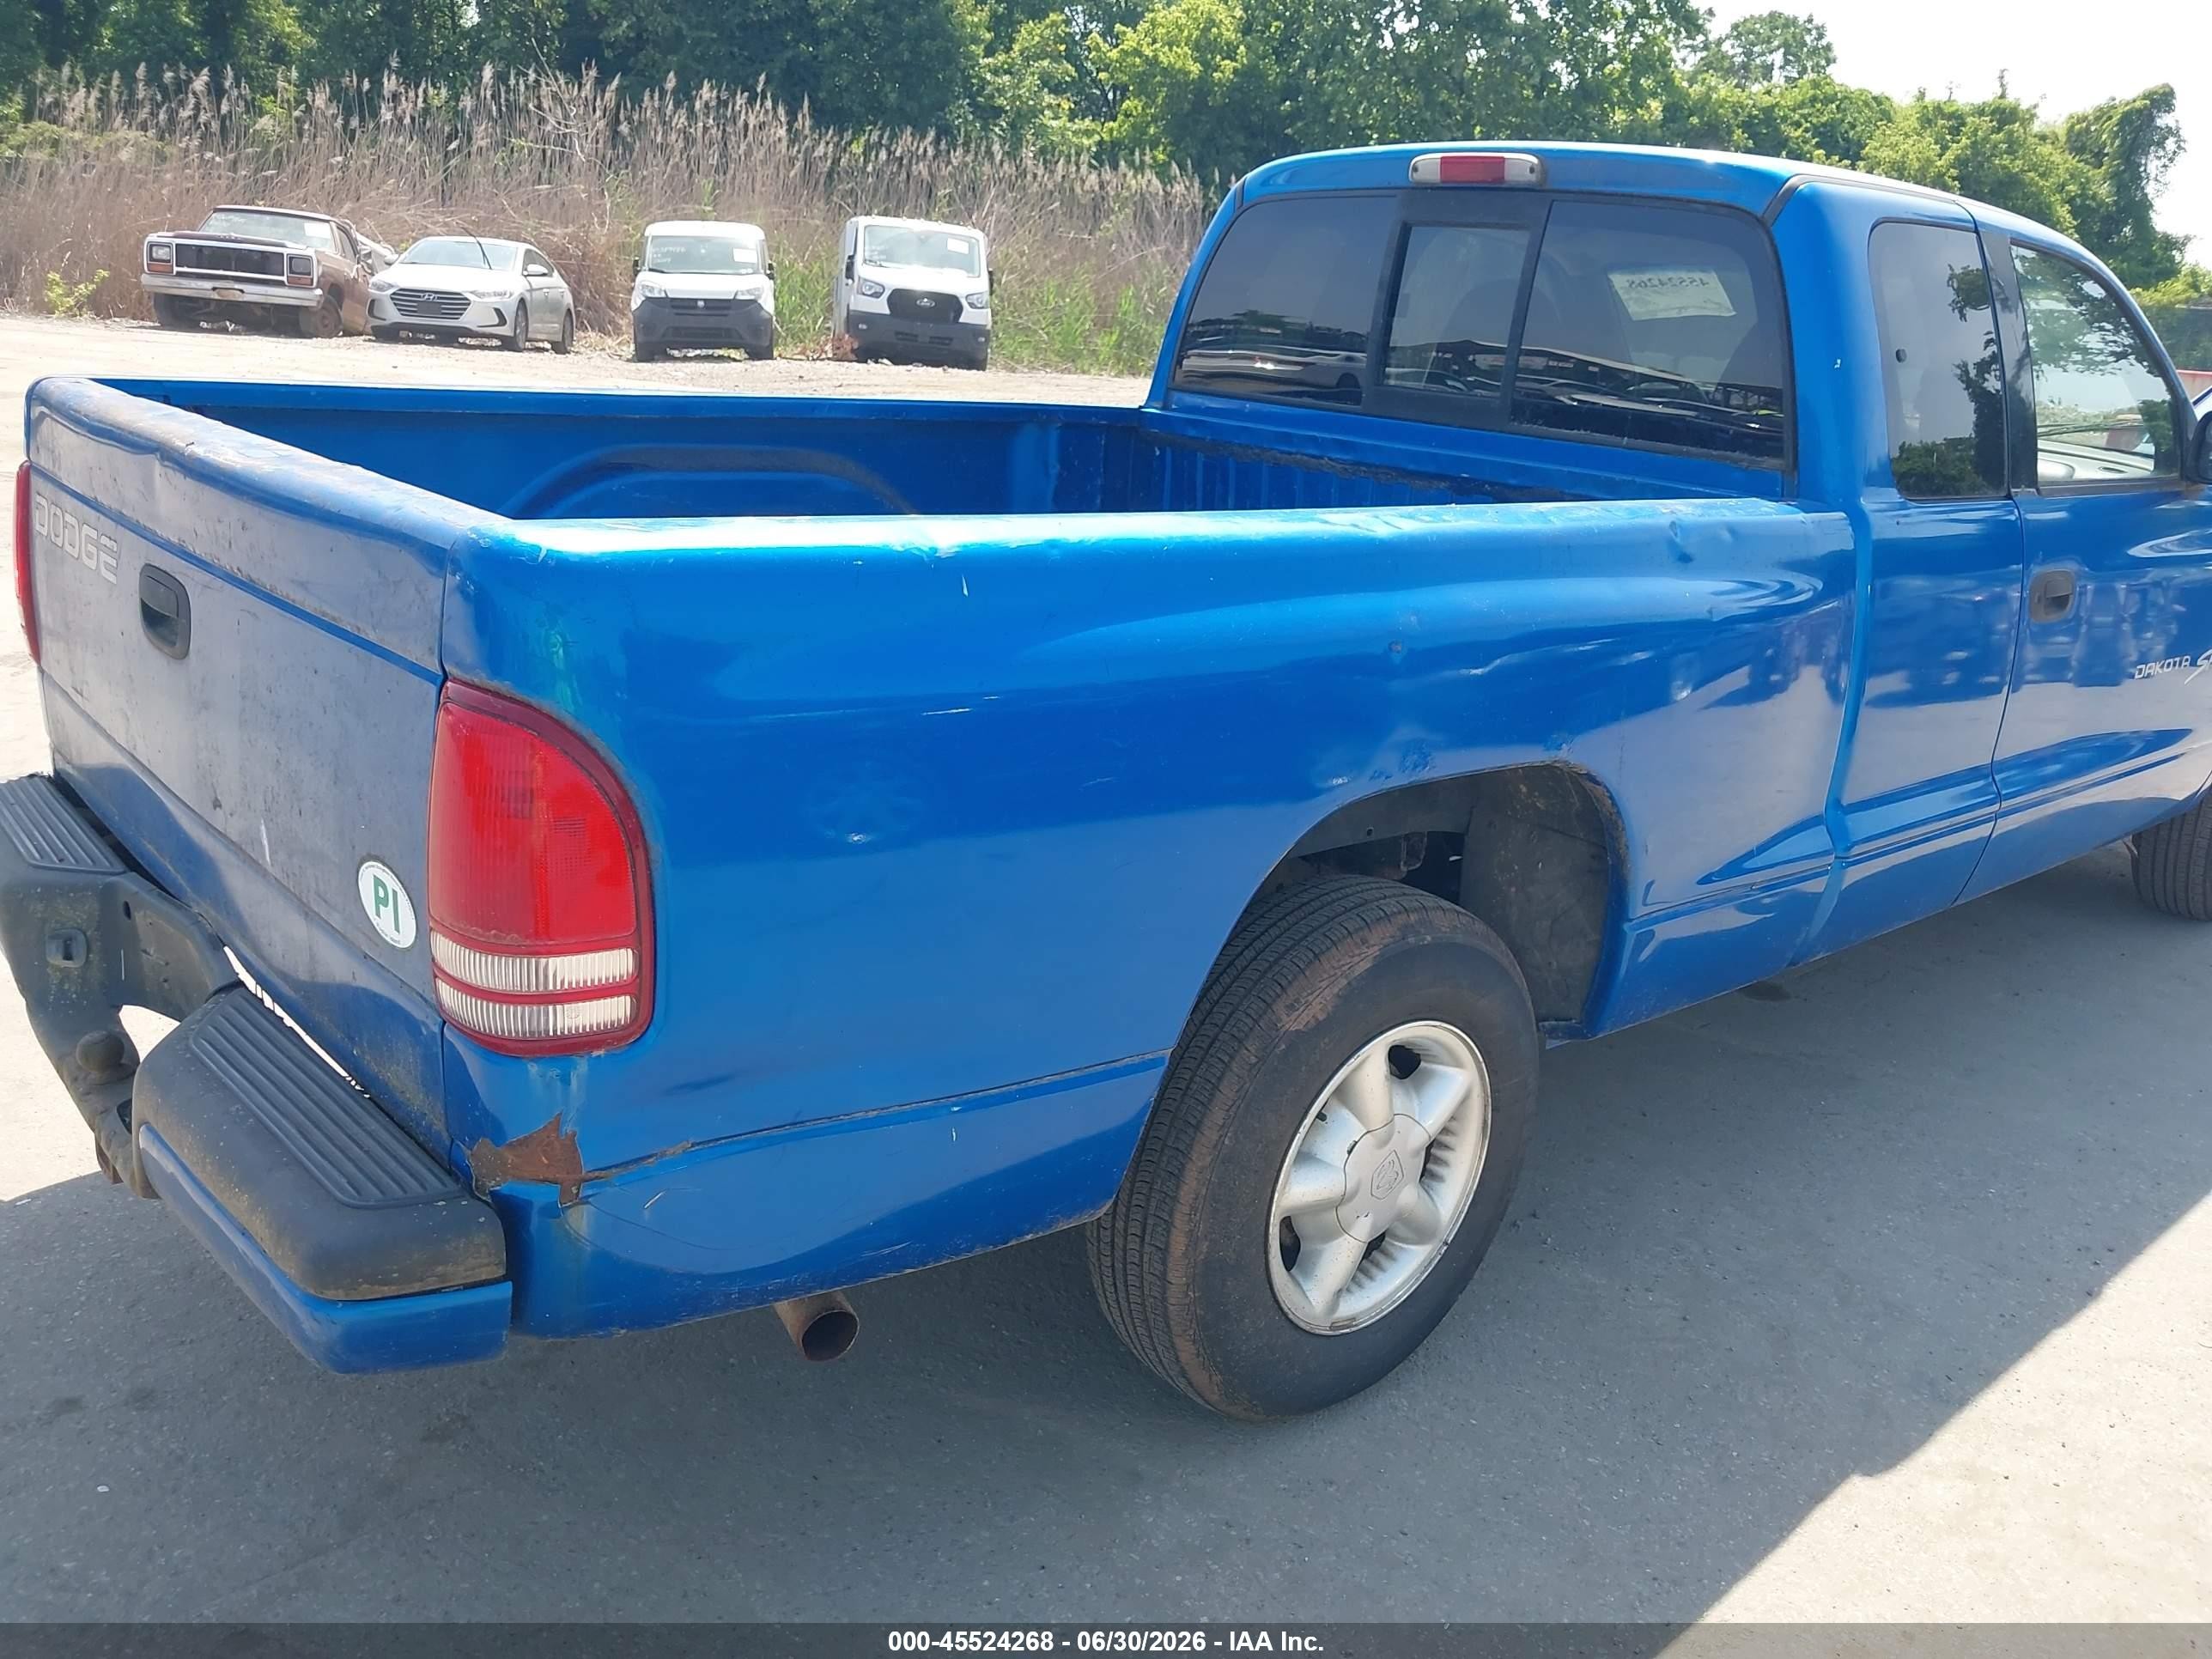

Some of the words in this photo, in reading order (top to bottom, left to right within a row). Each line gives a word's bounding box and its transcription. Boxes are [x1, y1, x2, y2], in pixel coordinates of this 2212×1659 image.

[34, 491, 118, 585] DODGE
[2134, 654, 2191, 679] DAKOTA
[2184, 648, 2212, 685] S
[373, 874, 401, 935] PI
